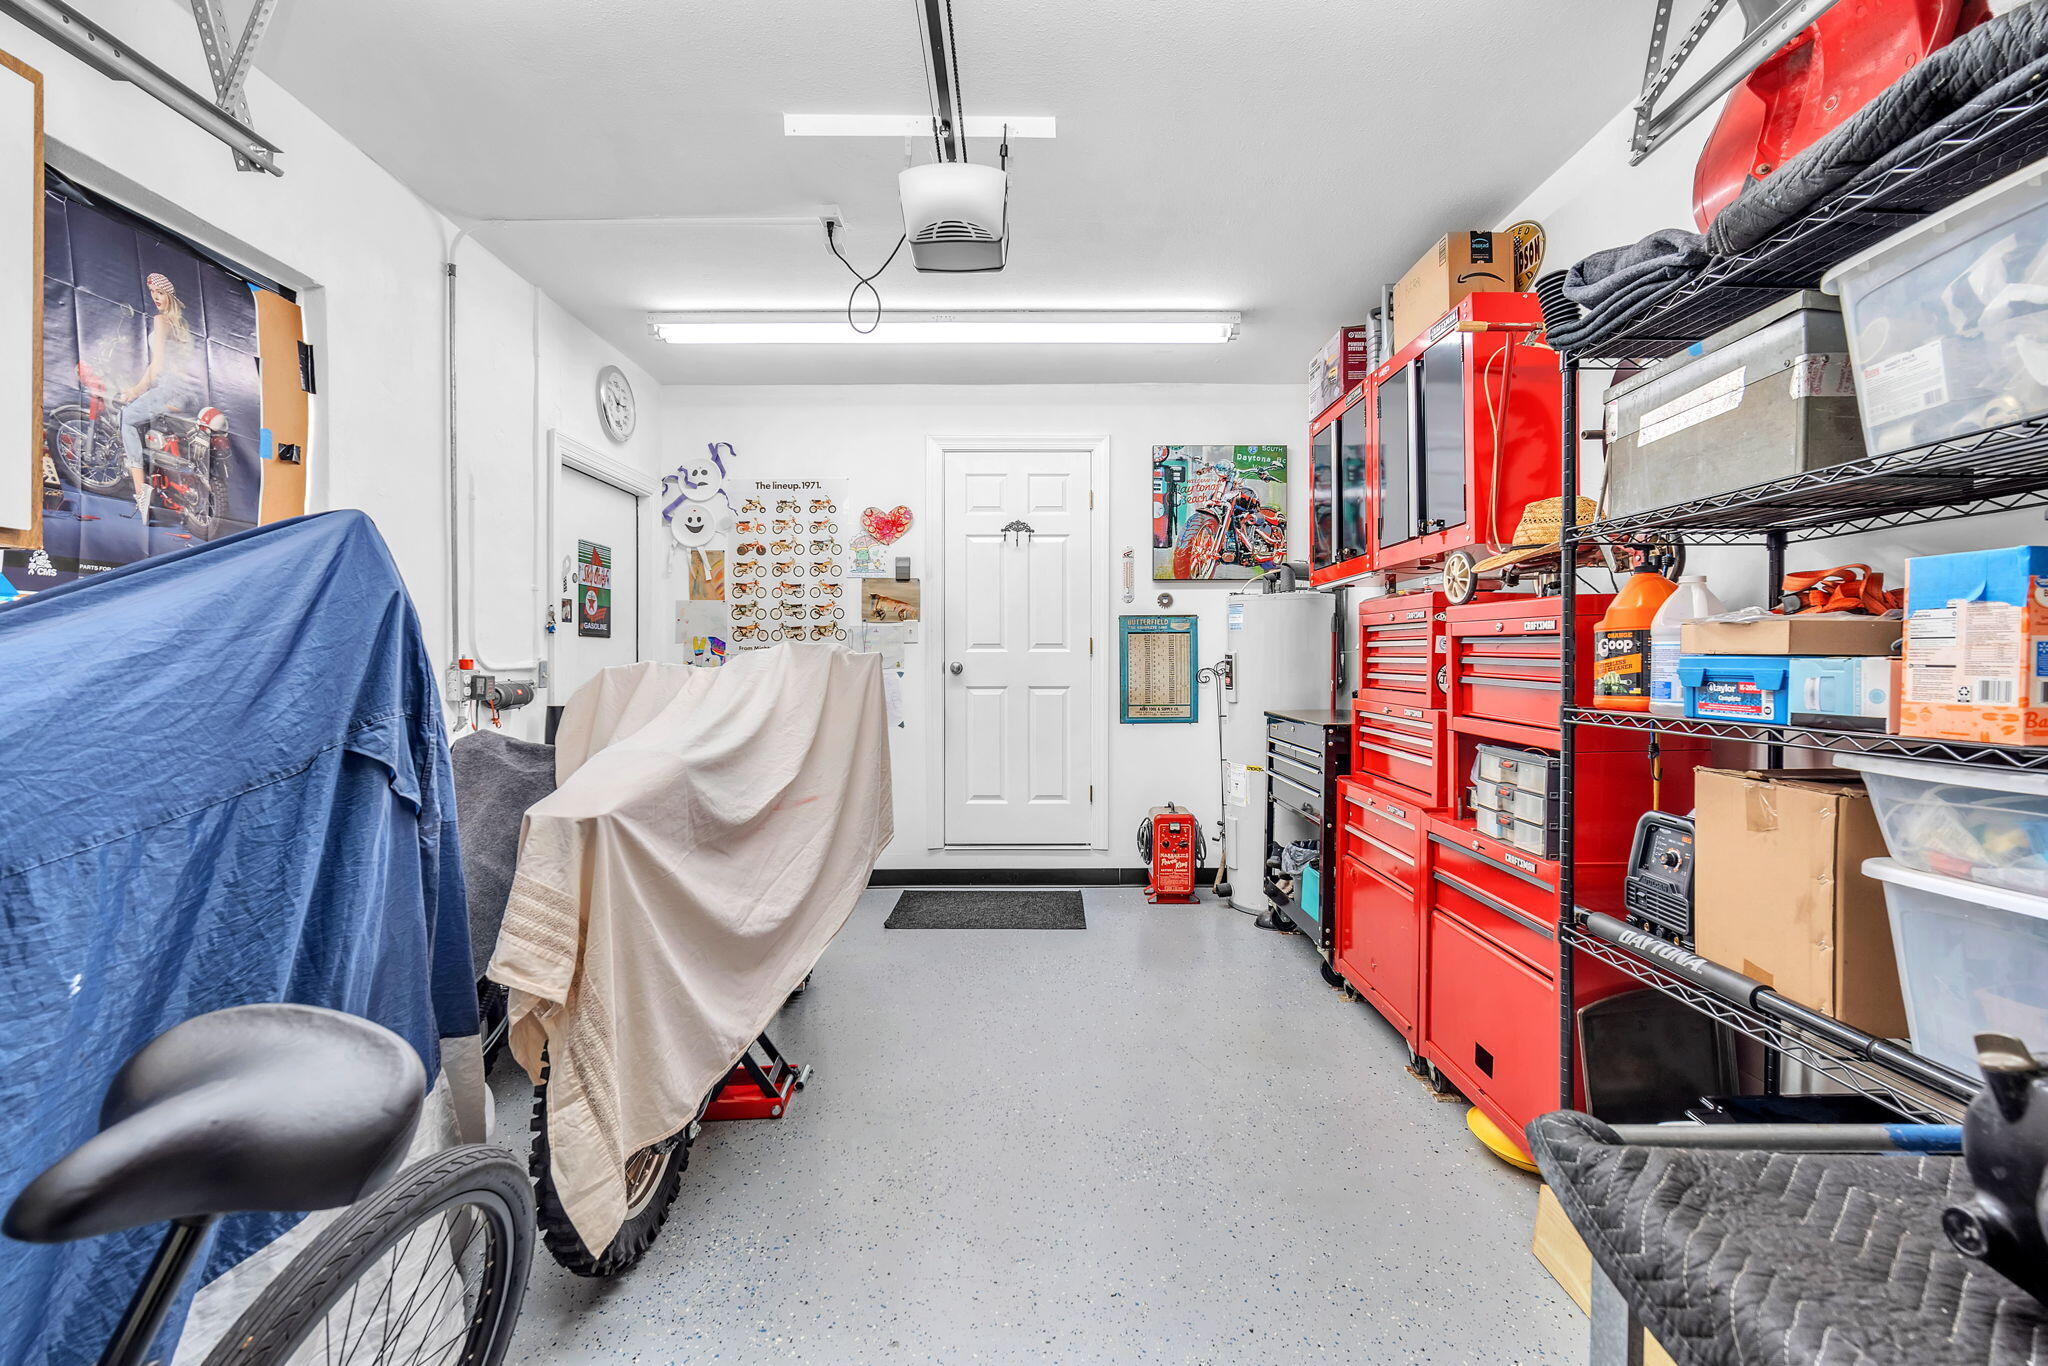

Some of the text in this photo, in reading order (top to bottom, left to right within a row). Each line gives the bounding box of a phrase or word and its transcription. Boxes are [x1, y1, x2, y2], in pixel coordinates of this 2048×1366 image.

[1237, 453, 1271, 463] Daytona
[755, 481, 822, 492] The lineup. 1971.
[37, 567, 58, 577] CMS
[79, 563, 99, 571] PARTS
[583, 621, 608, 631] GASOLINE
[1524, 620, 1556, 631] CRAFTSMAN
[1713, 683, 1758, 693] taylor K-200
[1718, 694, 1742, 703] Complete
[2024, 711, 2048, 729] Ba
[1618, 929, 1708, 974] DAYTONA
